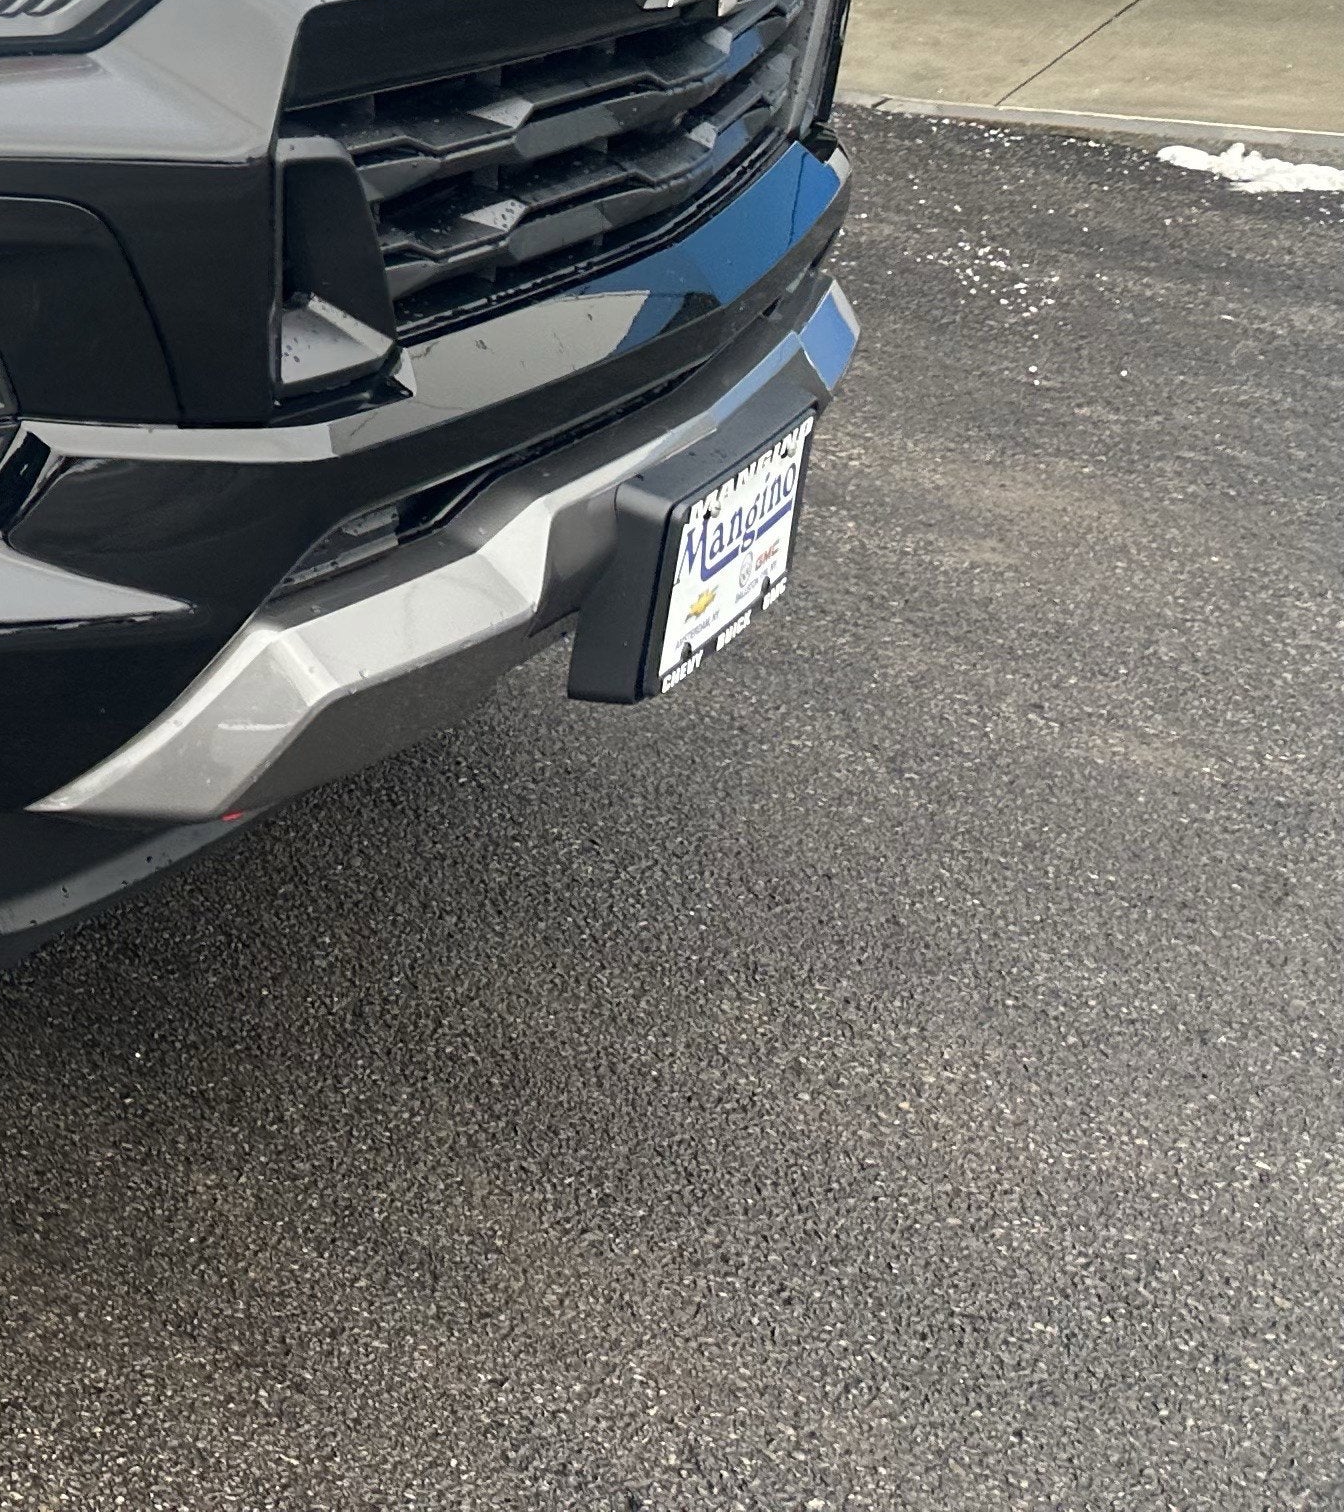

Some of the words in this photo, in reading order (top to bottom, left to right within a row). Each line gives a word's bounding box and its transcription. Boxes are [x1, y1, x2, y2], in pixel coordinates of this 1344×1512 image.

[675, 462, 797, 583] Mangino
[661, 649, 704, 694] CHEVY
[716, 609, 752, 652] BUICK
[762, 577, 788, 611] GMC
